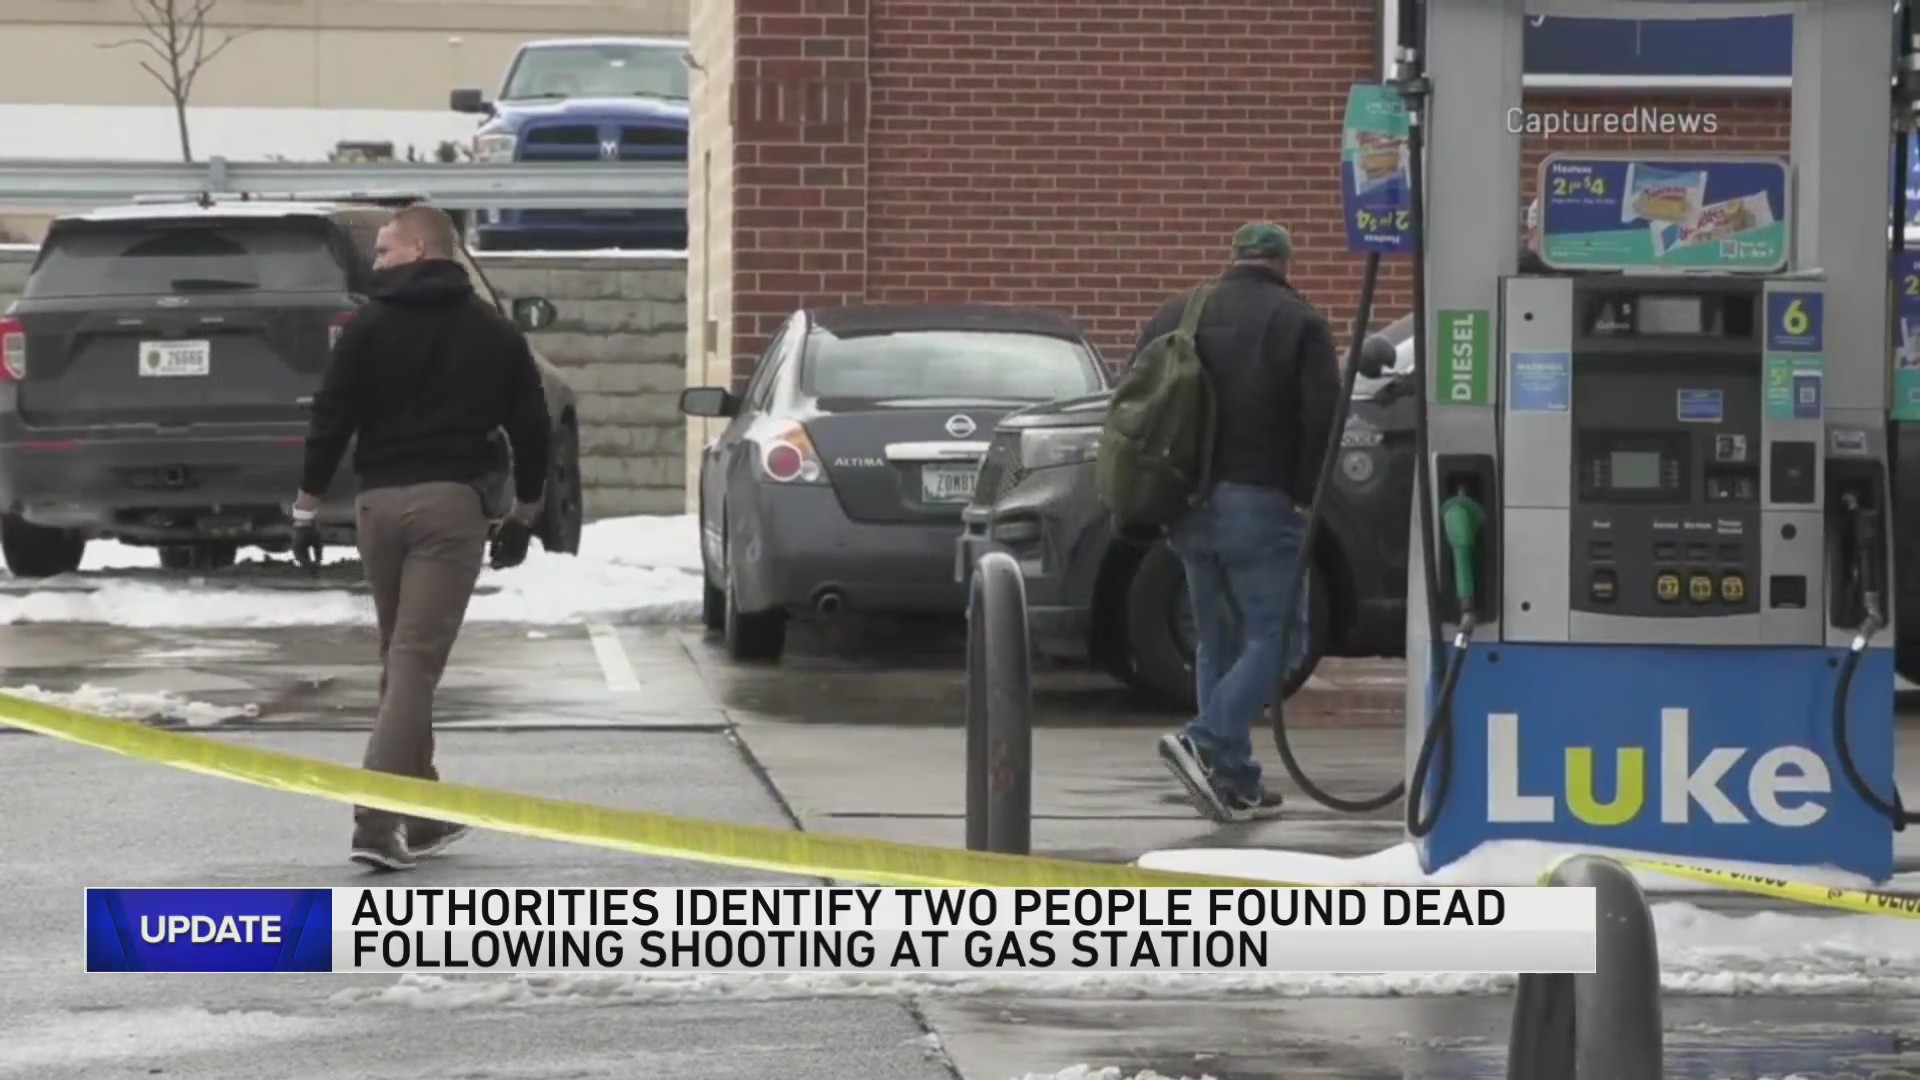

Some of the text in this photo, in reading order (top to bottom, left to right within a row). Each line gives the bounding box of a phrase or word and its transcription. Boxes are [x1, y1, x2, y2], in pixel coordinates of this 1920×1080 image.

[1553, 178, 1568, 196] 2
[1783, 299, 1809, 335] 6
[1451, 313, 1473, 400] DIESEL
[834, 457, 884, 467] ALTIMA
[1487, 708, 1831, 826] Luke
